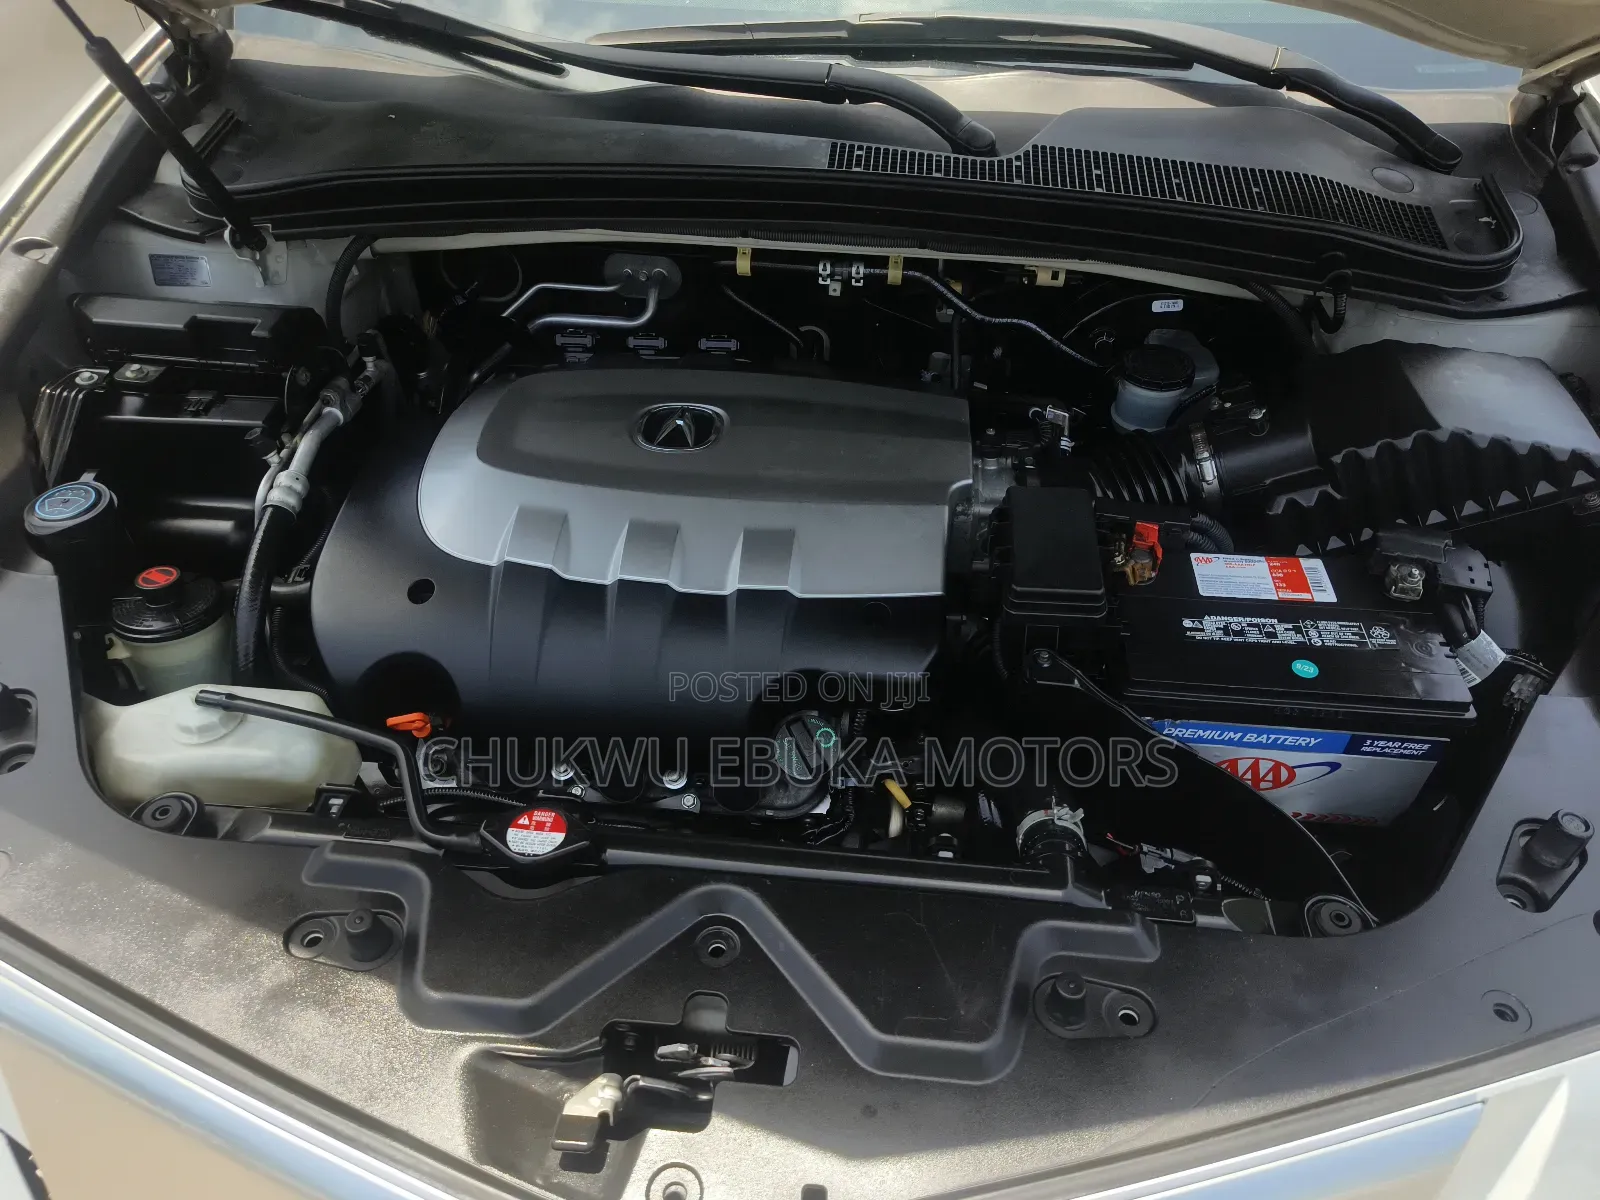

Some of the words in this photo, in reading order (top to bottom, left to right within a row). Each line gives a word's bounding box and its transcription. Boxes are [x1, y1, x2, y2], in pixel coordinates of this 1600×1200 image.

[1162, 727, 1243, 742] PREMIUM
[1242, 733, 1323, 748] BATTERY
[1373, 740, 1402, 749] YEAR
[1401, 742, 1432, 750] FREE
[1360, 746, 1427, 756] REPLACEMENT
[1215, 757, 1291, 791] AAA
